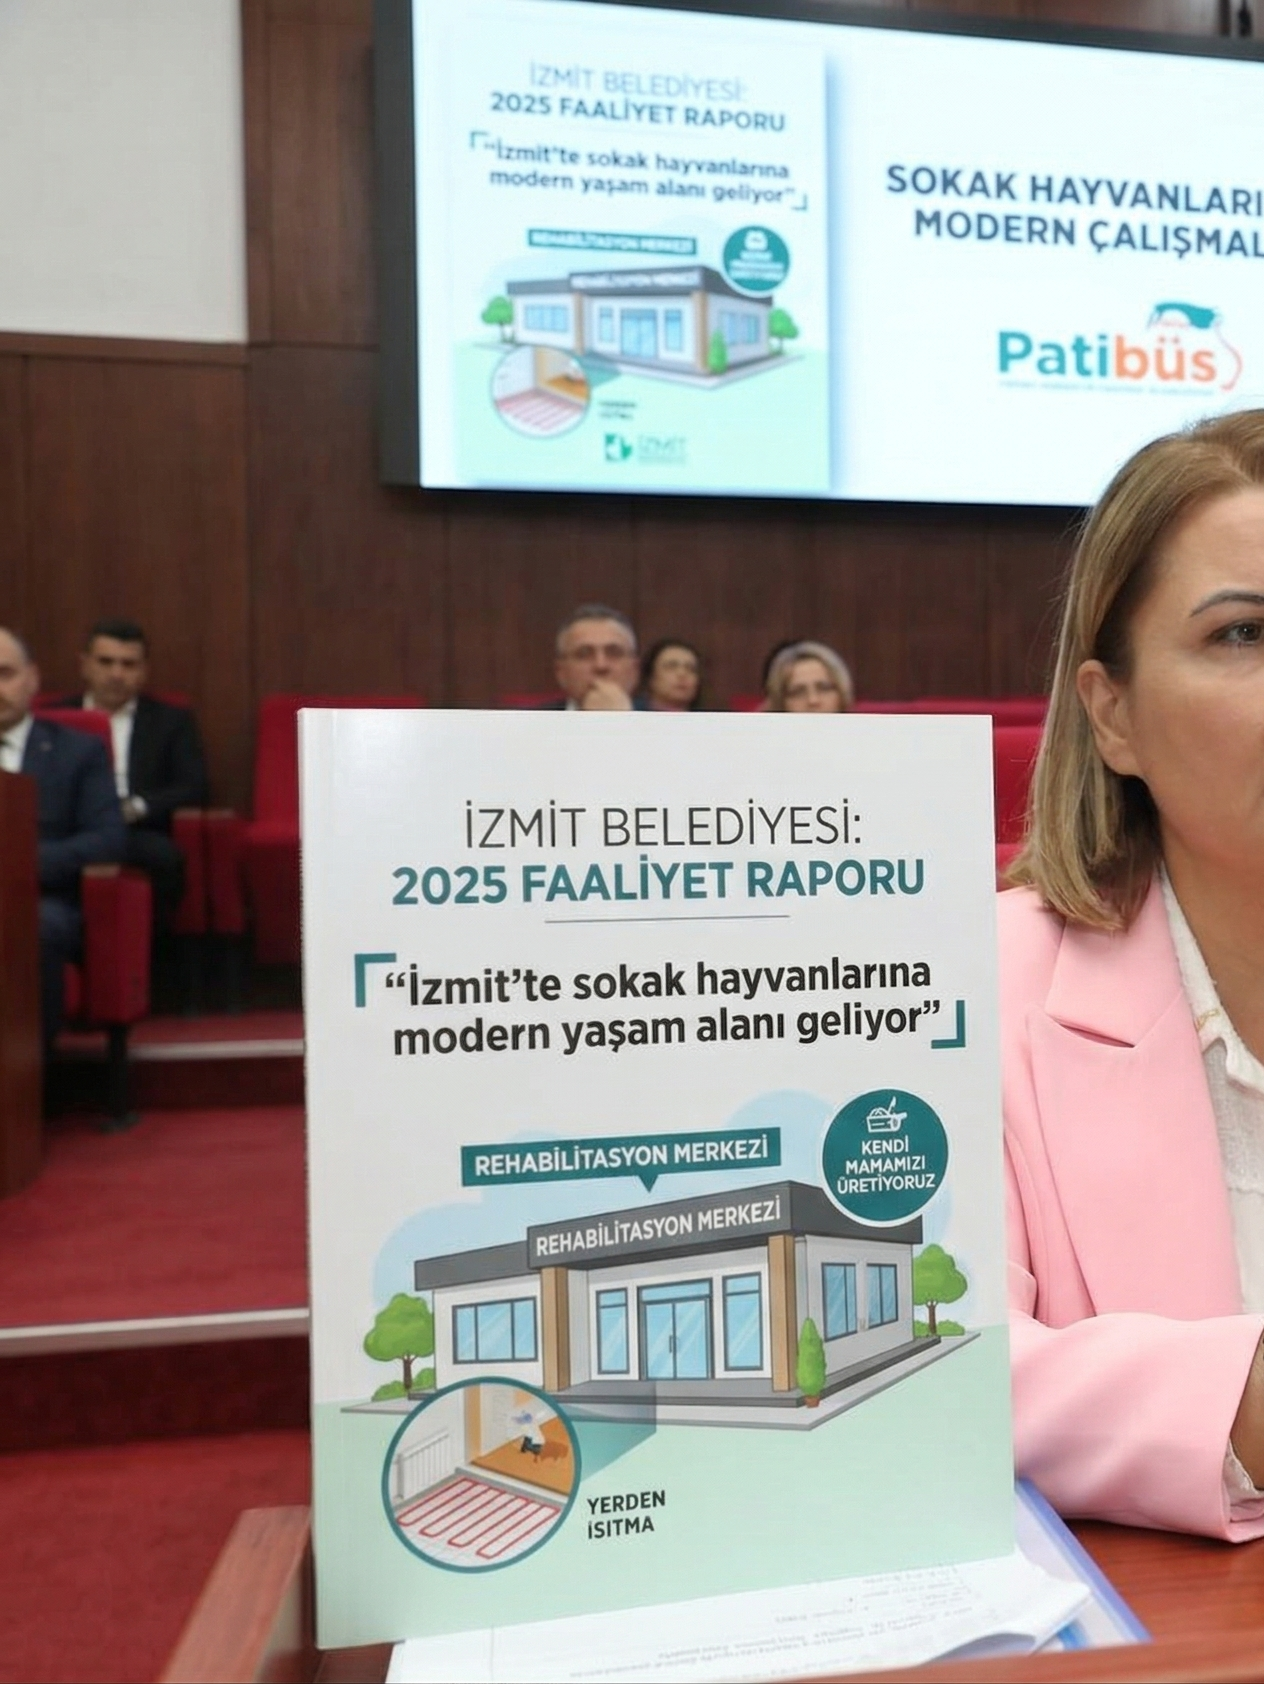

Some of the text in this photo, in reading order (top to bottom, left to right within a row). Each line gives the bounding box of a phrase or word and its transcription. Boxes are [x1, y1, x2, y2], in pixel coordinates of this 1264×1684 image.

[530, 61, 595, 90] İZMİT
[490, 92, 786, 132] 2025 FAALİYET RAPORU
[489, 168, 574, 191] modern
[580, 177, 650, 199] yaşam
[656, 177, 706, 199] alanı
[587, 146, 648, 171] sokak
[656, 154, 790, 182] hayvanlarına
[886, 163, 1018, 200] SOKAK
[1030, 174, 1262, 218] HAYVANLARI
[914, 208, 1076, 247] MODERN
[997, 330, 1218, 384] Patibüs
[465, 798, 863, 849] İZMİT BELEDİYESİ:
[391, 854, 925, 906] 2025 FAALİYET RAPORU
[573, 962, 686, 1000] sokak
[697, 956, 932, 1000] hayvanlarına
[394, 1014, 552, 1056] modern
[562, 1014, 686, 1054] yaşam
[696, 1008, 786, 1044] alanı
[474, 1132, 770, 1178] REHABİLİTASYON MERKEZİ
[845, 1155, 926, 1175] MAMAMIZI
[861, 1134, 909, 1156] KENDİ
[837, 1172, 936, 1195] ÜRETİYORUZ
[535, 1194, 782, 1258] REHABİLİTASYON MERKEZİ
[587, 1489, 665, 1515] YERDEN
